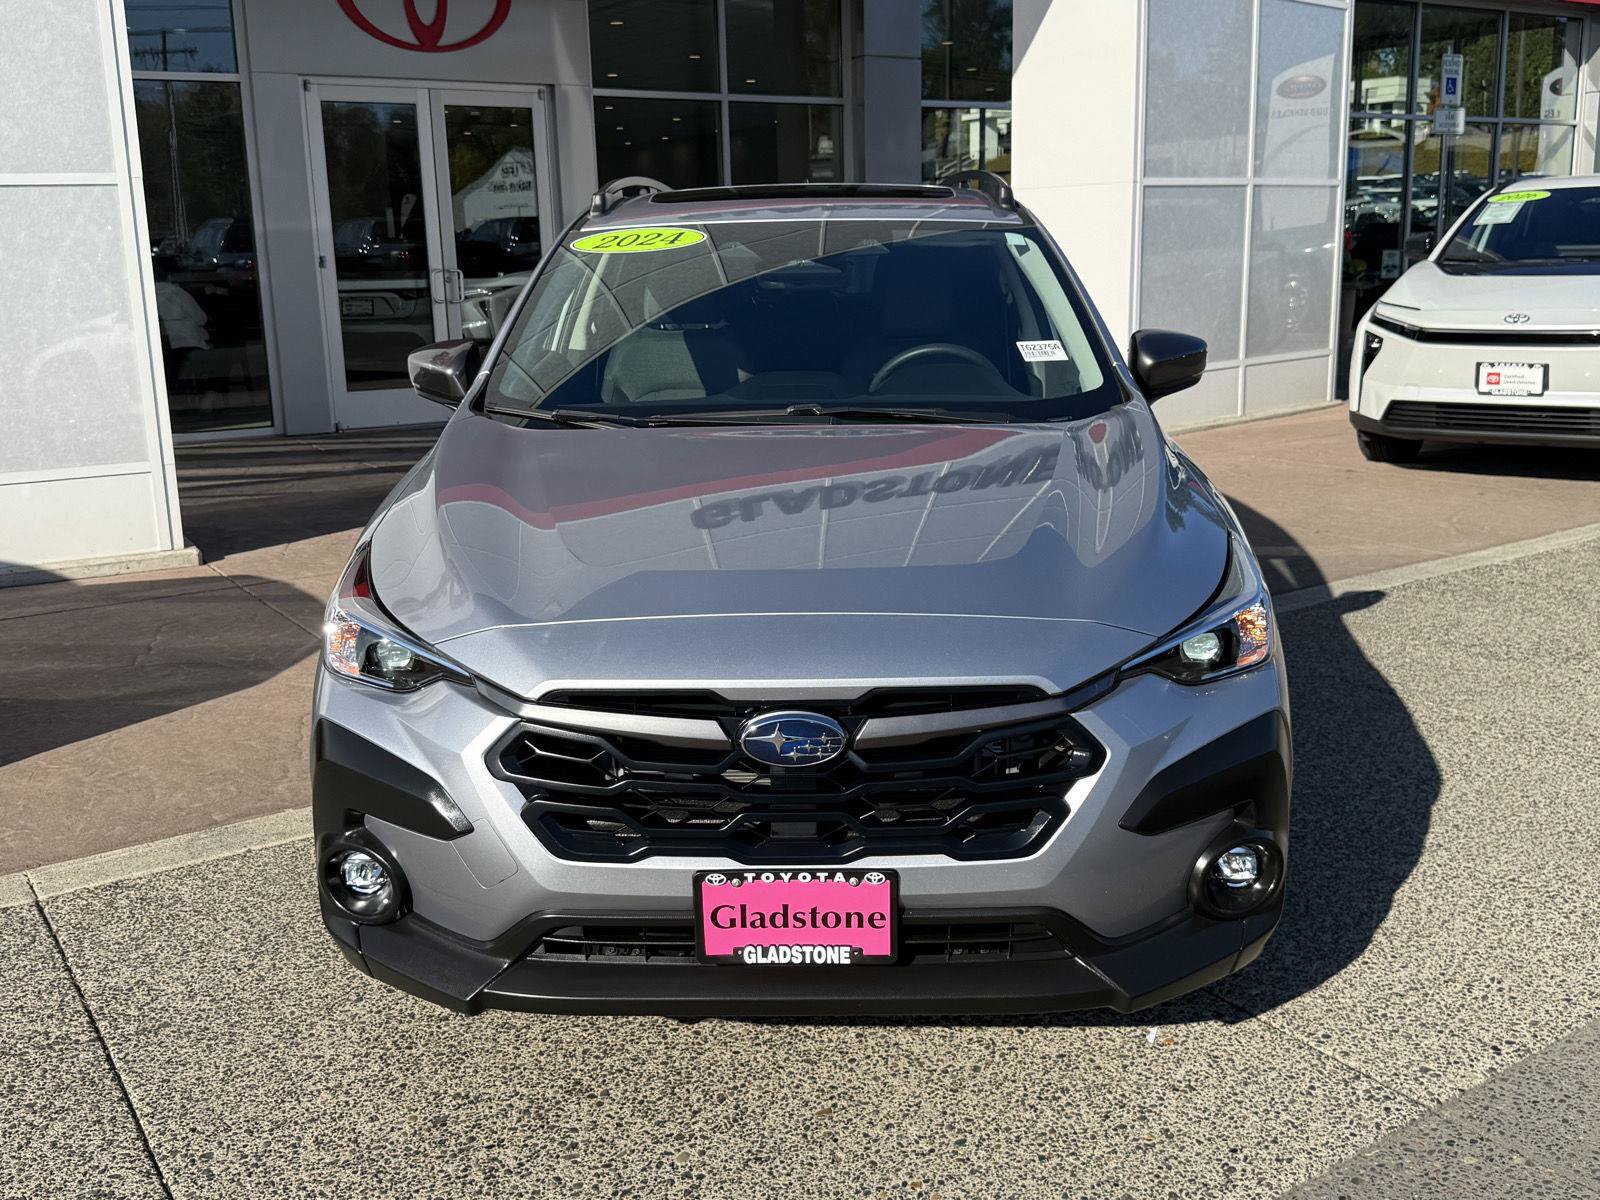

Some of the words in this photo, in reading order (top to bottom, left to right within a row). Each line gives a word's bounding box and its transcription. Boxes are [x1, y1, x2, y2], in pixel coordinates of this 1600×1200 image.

[592, 232, 686, 250] 2024
[744, 872, 846, 884] TOYOTA
[709, 903, 887, 930] Gladstone
[743, 945, 851, 965] GLADSTONE
